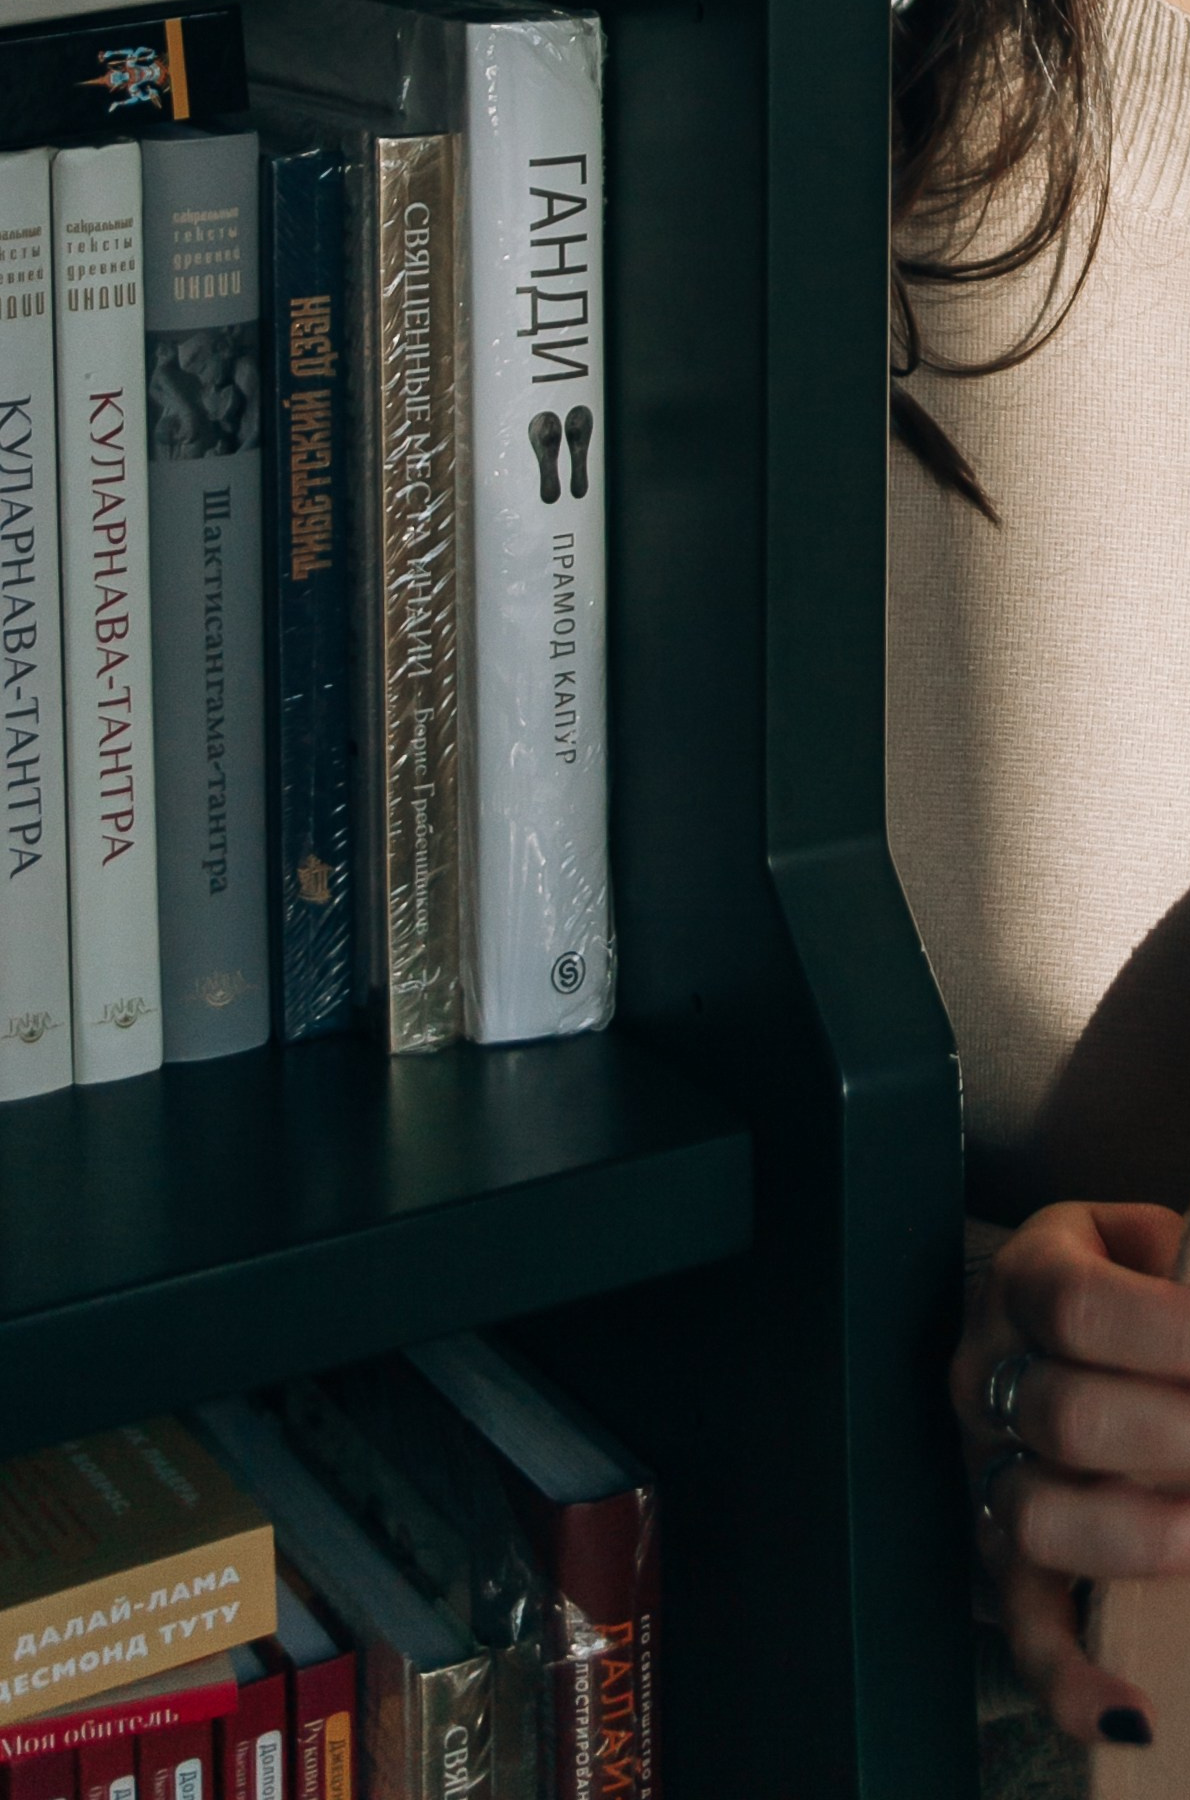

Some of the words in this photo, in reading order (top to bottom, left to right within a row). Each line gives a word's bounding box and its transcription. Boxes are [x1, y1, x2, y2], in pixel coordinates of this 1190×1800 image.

[66, 217, 134, 237] сакральные
[67, 237, 133, 254] тексты
[516, 153, 590, 383] ГАНДИ
[290, 295, 339, 378] ДЗЭН
[404, 202, 431, 423] СВЯЩЕННЫЕ
[282, 388, 333, 581] ТИБЕТСКИЙ
[405, 432, 432, 542] МЕСТА
[0, 393, 44, 879] КУЛАРНАВА-ТАНТРА
[88, 387, 136, 867] КУЛАРНАВА-ТАНТРА
[550, 532, 578, 662] ПРАМОД
[202, 486, 232, 896] Шактисангама-тантра
[413, 707, 435, 777] Борис
[553, 673, 578, 765] КАПУР
[14, 1565, 240, 1662] ДАЛАЙ-ЛАМА
[158, 1601, 240, 1645] ТУТУ
[0, 1731, 56, 1757] Моя
[63, 1708, 180, 1747] обитель
